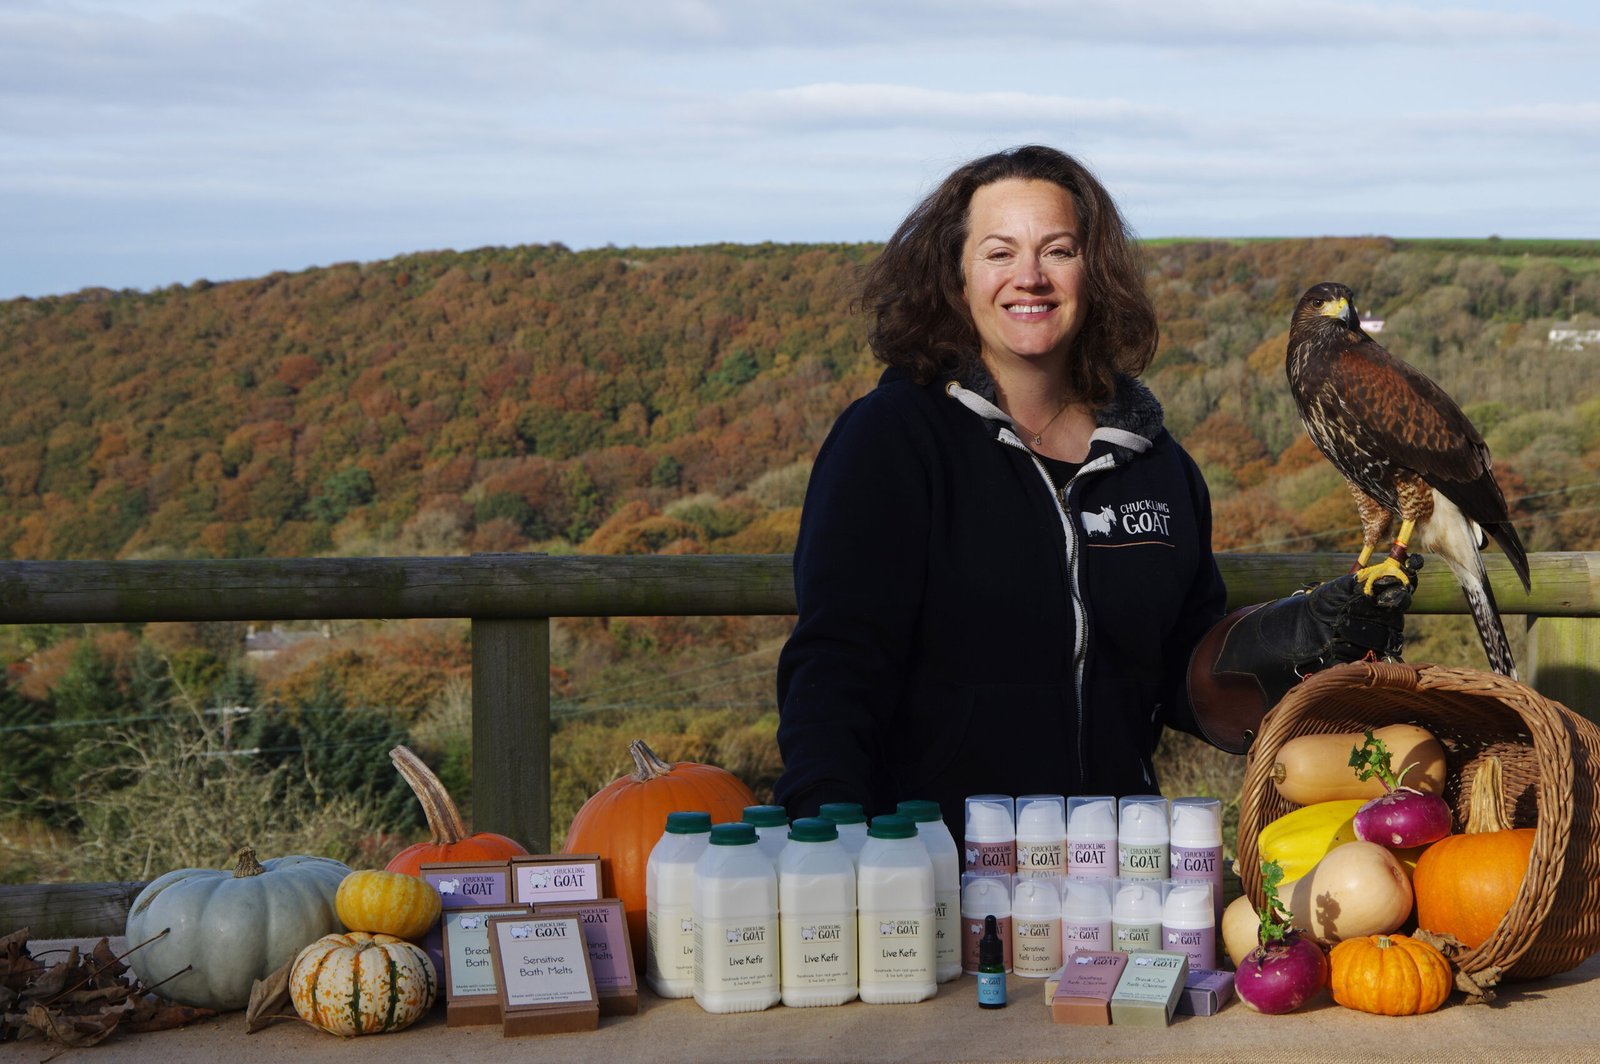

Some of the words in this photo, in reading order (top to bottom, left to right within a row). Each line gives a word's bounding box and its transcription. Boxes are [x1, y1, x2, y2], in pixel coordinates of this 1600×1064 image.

[1120, 500, 1170, 514] CHUCKLING
[1122, 511, 1170, 537] GOAT
[982, 846, 1012, 854] CHUCKLING
[1130, 848, 1161, 856] CHUCKLING
[982, 852, 1013, 866] GOAT
[1031, 852, 1062, 866] GOAT
[1075, 850, 1107, 864] GOAT
[1130, 854, 1162, 869] GOAT
[1184, 858, 1216, 873] GOAT
[554, 867, 585, 875] CHUCKLING
[554, 874, 585, 887] GOAT
[462, 883, 495, 896] GOAT
[535, 927, 568, 938] GOAT
[818, 929, 841, 940] GOAT
[897, 925, 920, 935] GOAT
[1030, 927, 1051, 937] GOAT
[743, 931, 766, 941] GOAT
[1079, 931, 1100, 940] GOAT
[1129, 932, 1151, 942] GOAT
[1181, 936, 1202, 945] GOAT
[684, 946, 694, 955] Liv
[883, 948, 897, 958] Live
[899, 948, 918, 958] Kefir
[1022, 944, 1046, 953] Sensitive
[523, 955, 565, 965] Sensitive
[590, 951, 614, 961] Melts
[730, 957, 744, 966] Live
[746, 954, 763, 965] Kefir
[805, 954, 819, 963] Live
[821, 953, 839, 963] Kefir
[1033, 954, 1050, 962] Lotion
[466, 958, 489, 968] Bath
[520, 967, 543, 977] Bath
[548, 966, 573, 976] Melts
